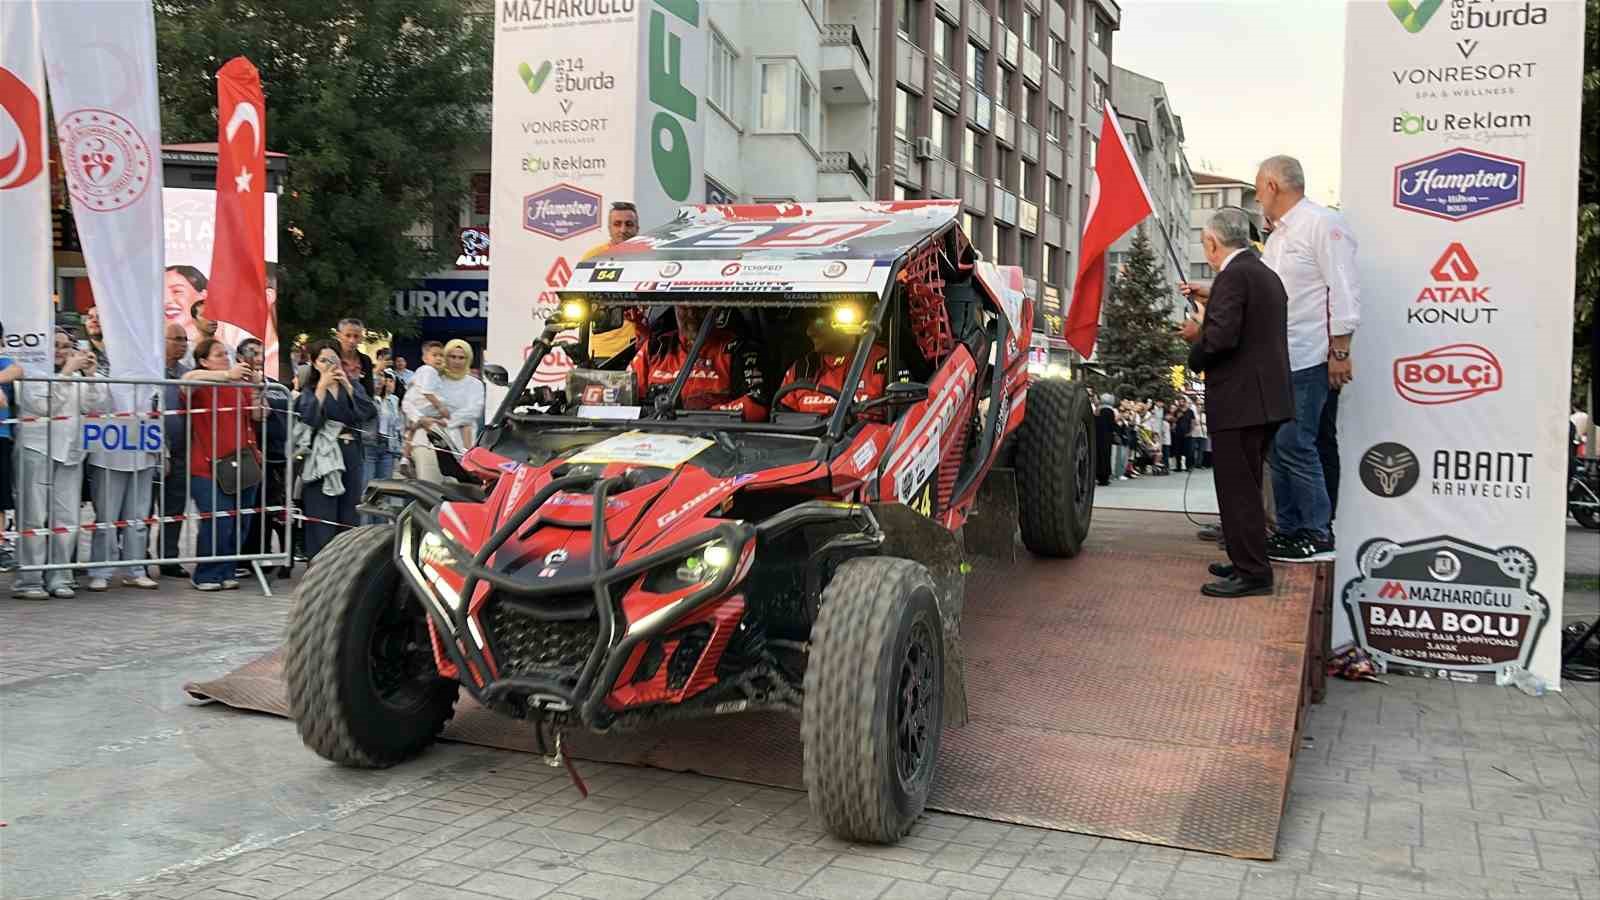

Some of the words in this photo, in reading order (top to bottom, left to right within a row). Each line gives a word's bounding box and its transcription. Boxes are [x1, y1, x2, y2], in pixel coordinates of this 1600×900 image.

[1466, 2, 1548, 29] burda
[566, 57, 584, 71] 14
[1392, 63, 1536, 84] VONRESORT
[566, 71, 614, 91] burda
[1453, 87, 1515, 97] WELLNESS
[521, 119, 608, 134] VONRESORT
[1393, 114, 1438, 134] Bolu
[1444, 112, 1531, 131] Reklam
[553, 155, 606, 169] Reklam
[1401, 168, 1517, 195] Hampton
[528, 200, 598, 220] Hampton
[597, 269, 617, 280] 54
[1416, 287, 1491, 303] ATAK
[1407, 307, 1499, 324] KONUT
[83, 421, 161, 450] POLİS
[1409, 586, 1512, 608] MAZHAROĞLU
[1370, 606, 1436, 631] BAJA
[1442, 611, 1520, 638] BOLU
